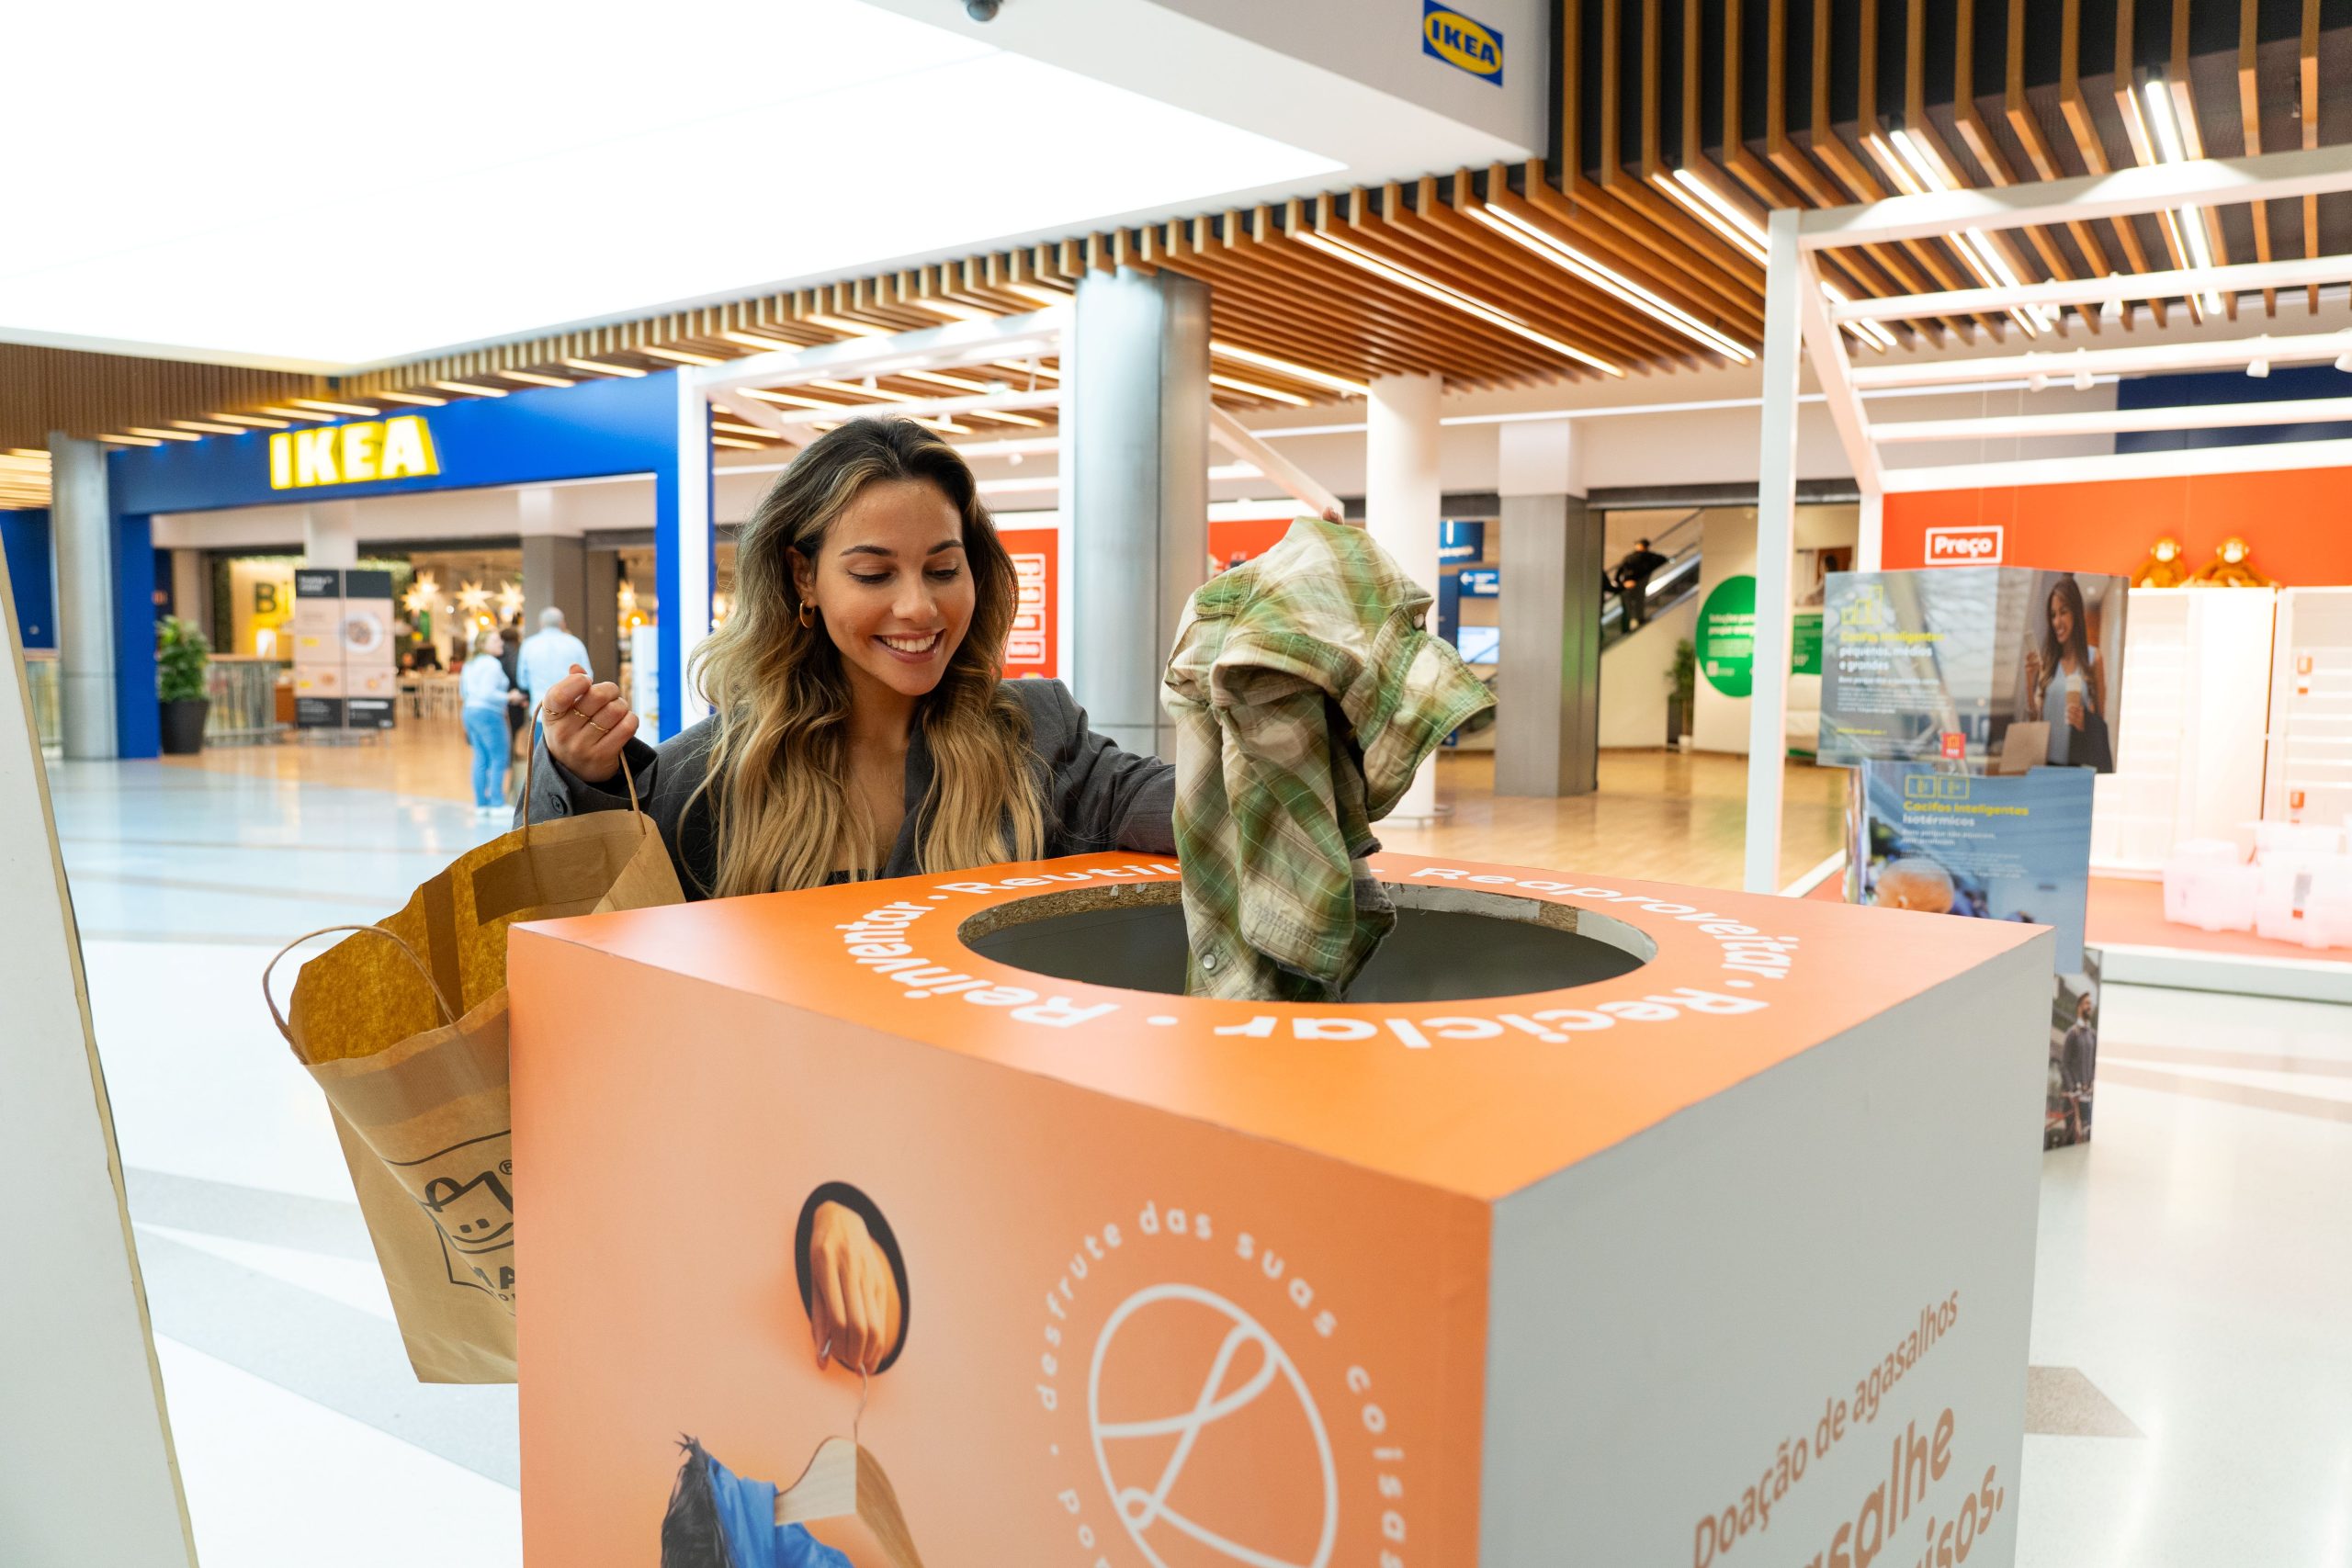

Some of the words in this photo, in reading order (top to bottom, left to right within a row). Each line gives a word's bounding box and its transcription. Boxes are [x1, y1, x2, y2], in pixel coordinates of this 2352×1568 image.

[1431, 18, 1496, 68] IKEA
[270, 414, 440, 490] IKEA
[1934, 535, 1993, 558] Preço
[1847, 660, 1889, 672] grandes
[1903, 814, 1975, 827] Isotérmicos
[1904, 800, 1951, 813] Cacifos
[1954, 802, 2029, 818] Inteligentes
[932, 863, 1181, 895] Reutil
[1409, 867, 1800, 980] Reaproveitar
[834, 901, 1121, 1028] Reinventar
[1213, 987, 1769, 1048] Reciclar
[1036, 1224, 1122, 1411] desfrute
[1139, 1200, 1212, 1240] das
[1236, 1232, 1337, 1337] suas
[1693, 1436, 1807, 1568] Doação
[1815, 1396, 1847, 1460] de
[1852, 1290, 1958, 1424] agasalhos
[1803, 1407, 1954, 1568] salhe
